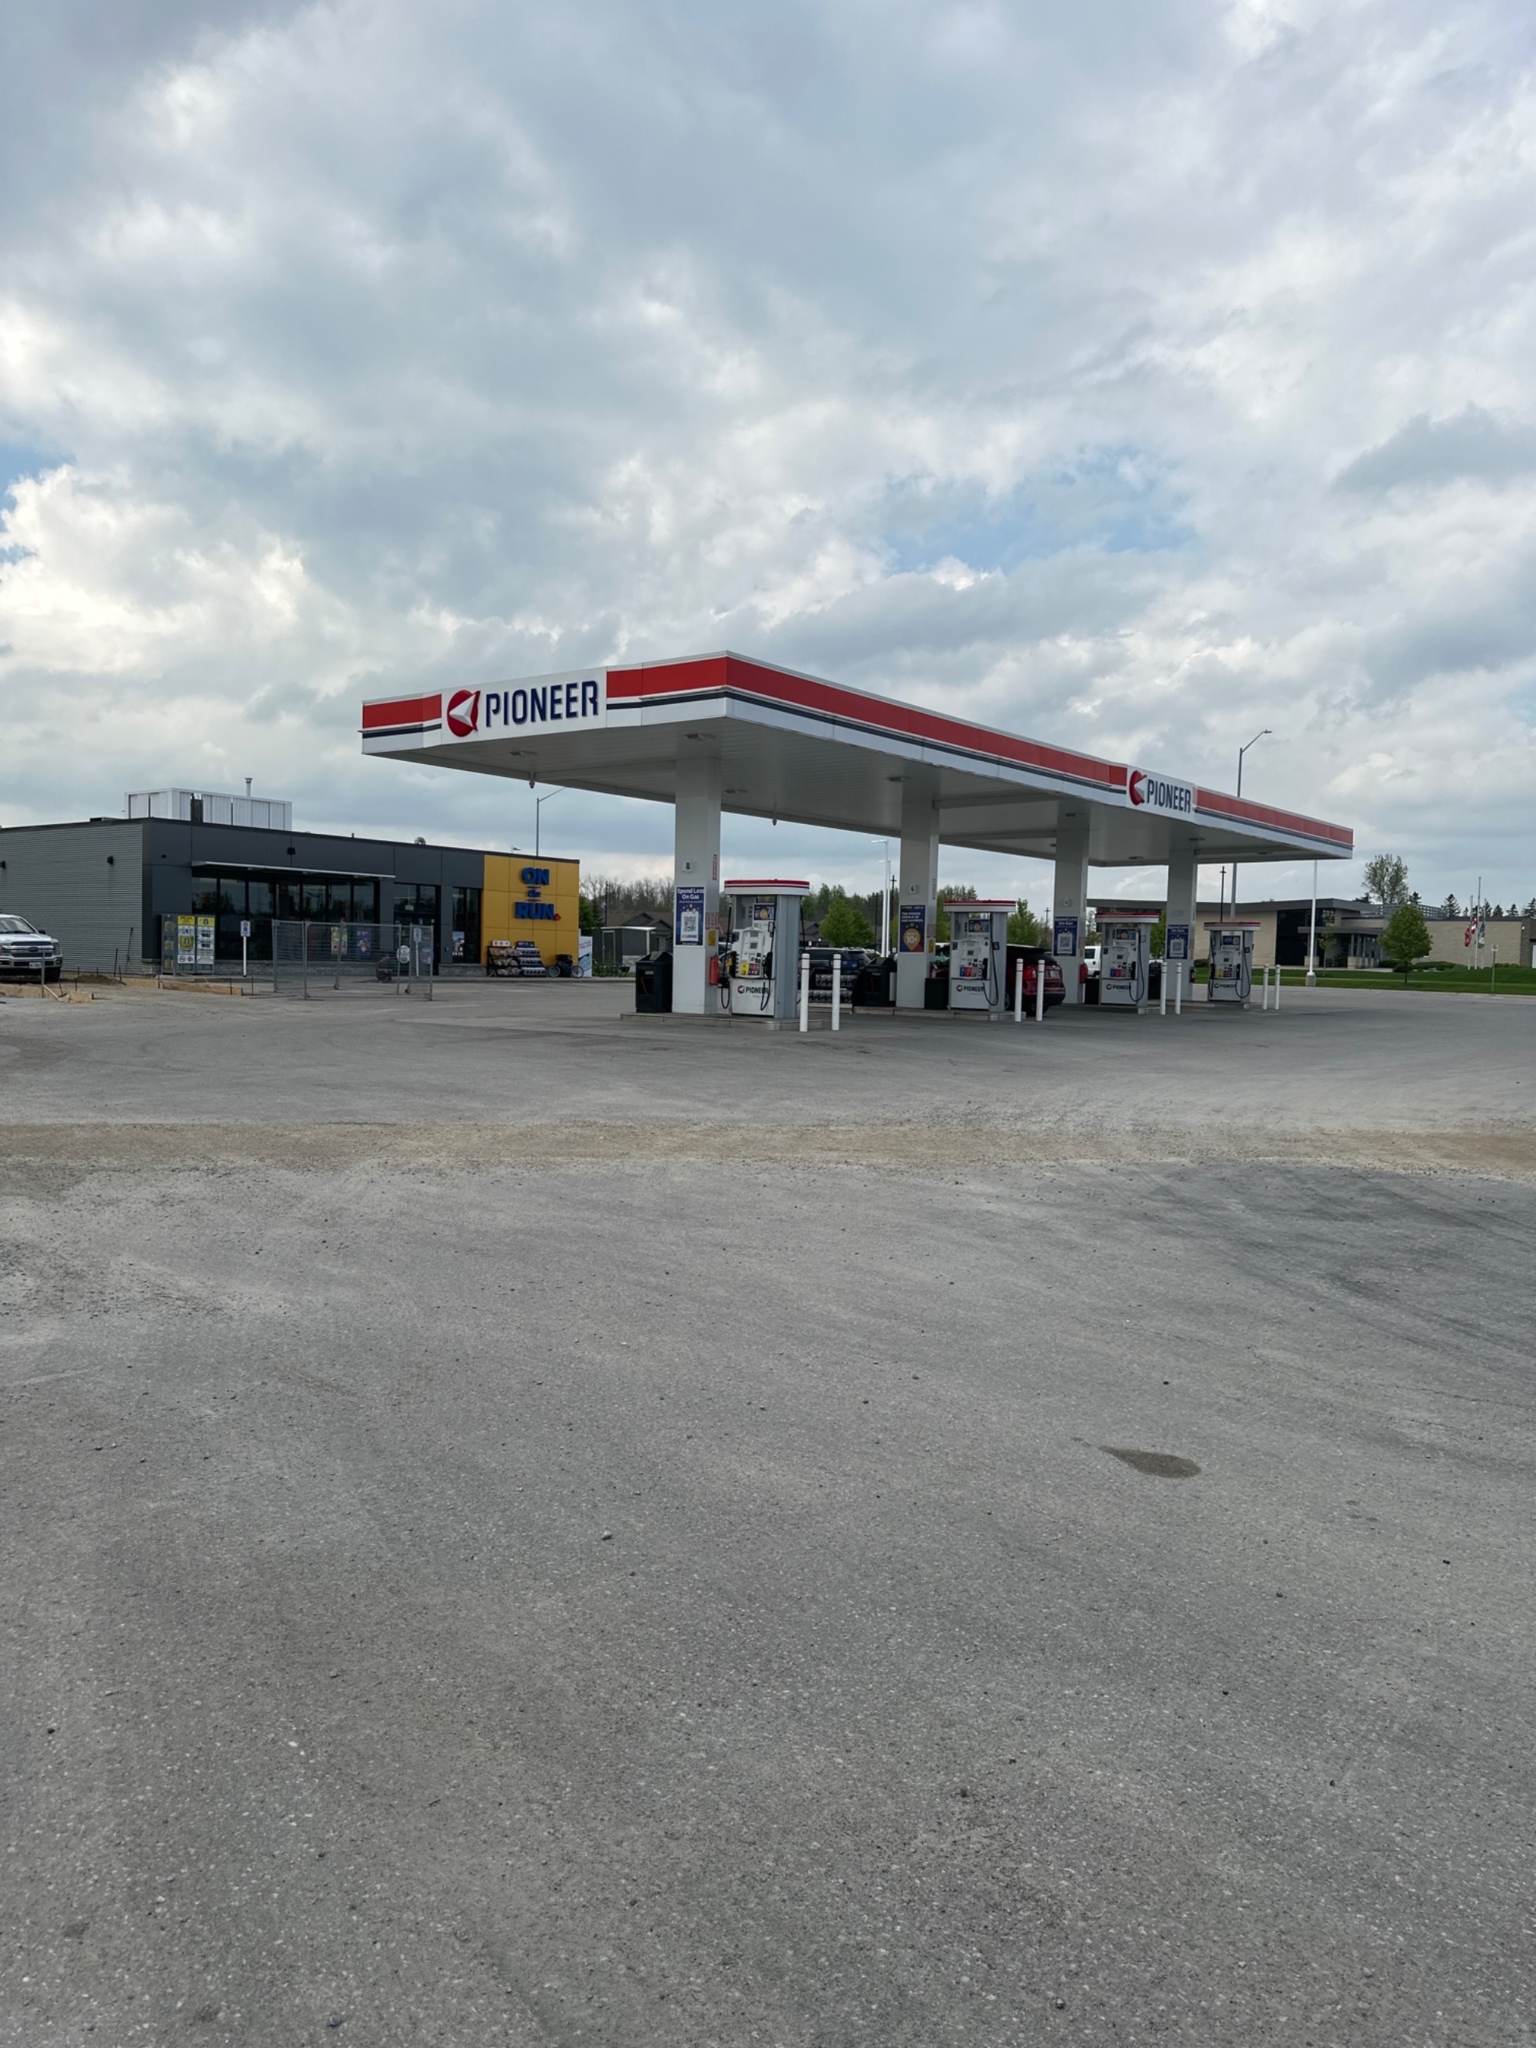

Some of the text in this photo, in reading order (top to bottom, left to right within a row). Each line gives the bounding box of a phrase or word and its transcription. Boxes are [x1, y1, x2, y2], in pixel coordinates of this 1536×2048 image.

[486, 680, 599, 728] PIONEER
[1146, 779, 1192, 814] PIONEER
[685, 862, 691, 870] 8
[521, 867, 550, 886] ON
[515, 902, 555, 920] RUN
